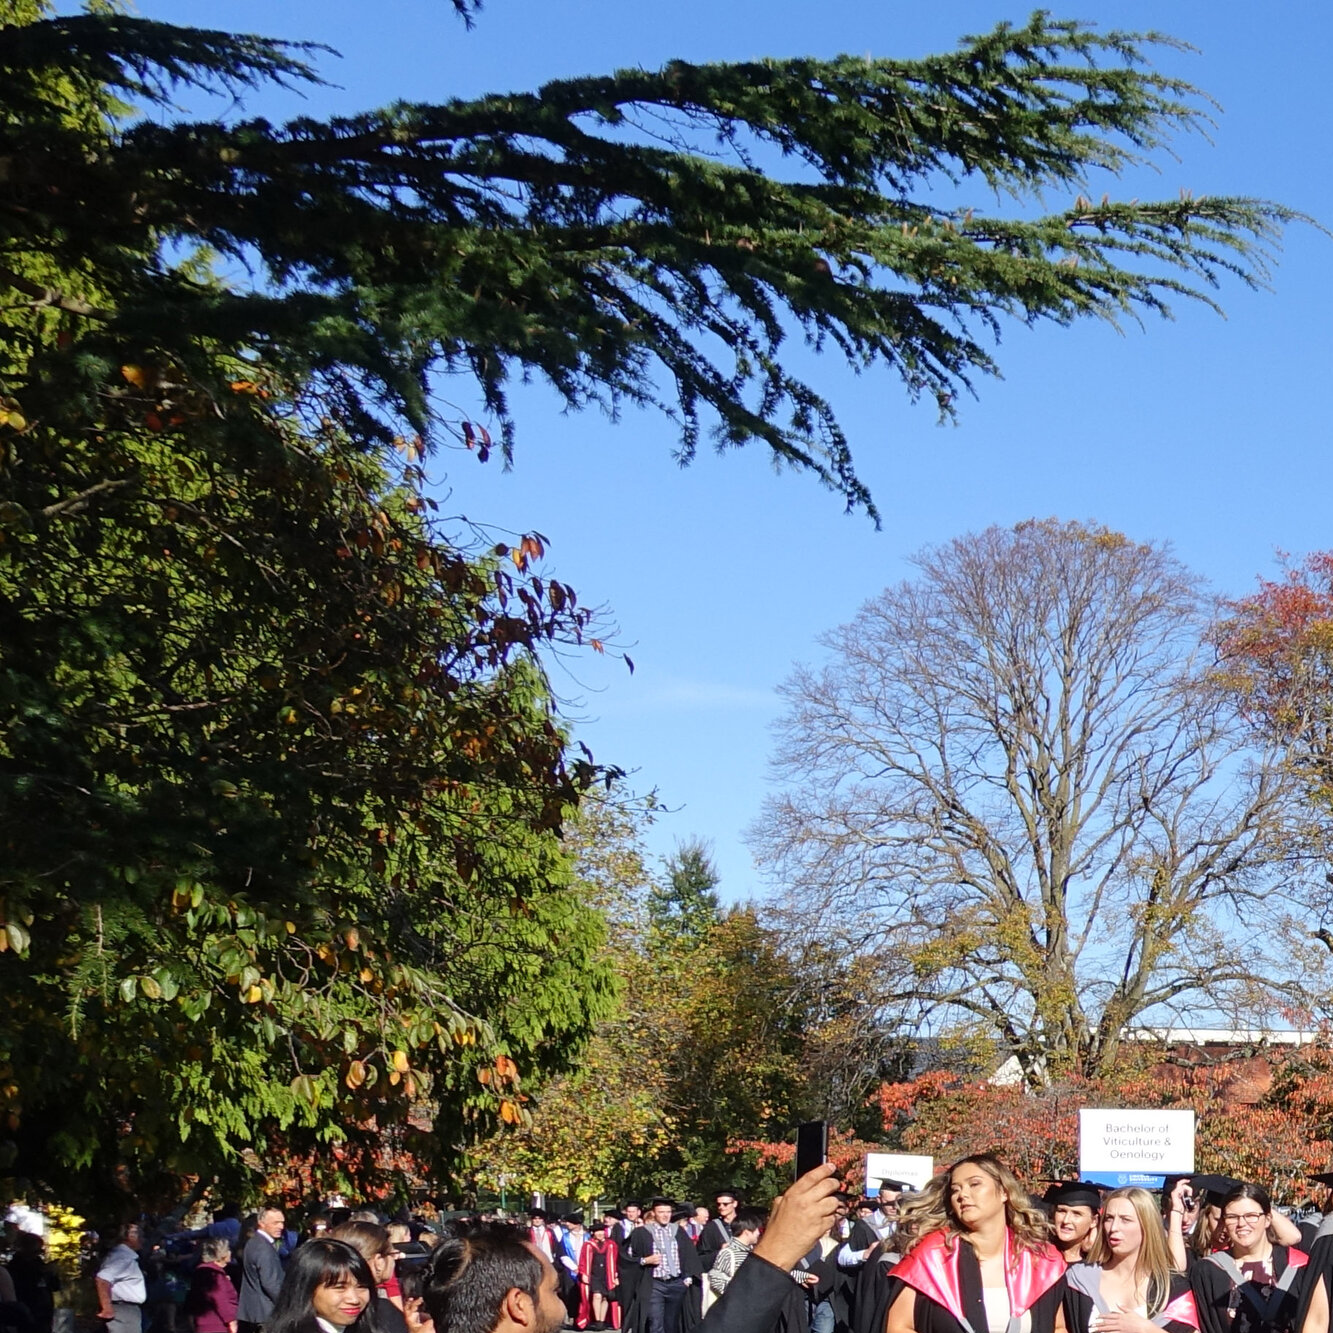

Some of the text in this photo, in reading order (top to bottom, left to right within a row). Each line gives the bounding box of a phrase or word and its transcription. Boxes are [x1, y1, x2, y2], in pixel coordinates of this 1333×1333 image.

[1105, 1123, 1169, 1133] Bachelor of
[1103, 1136, 1172, 1146] Viticulture &
[1110, 1149, 1165, 1161] Oenology
